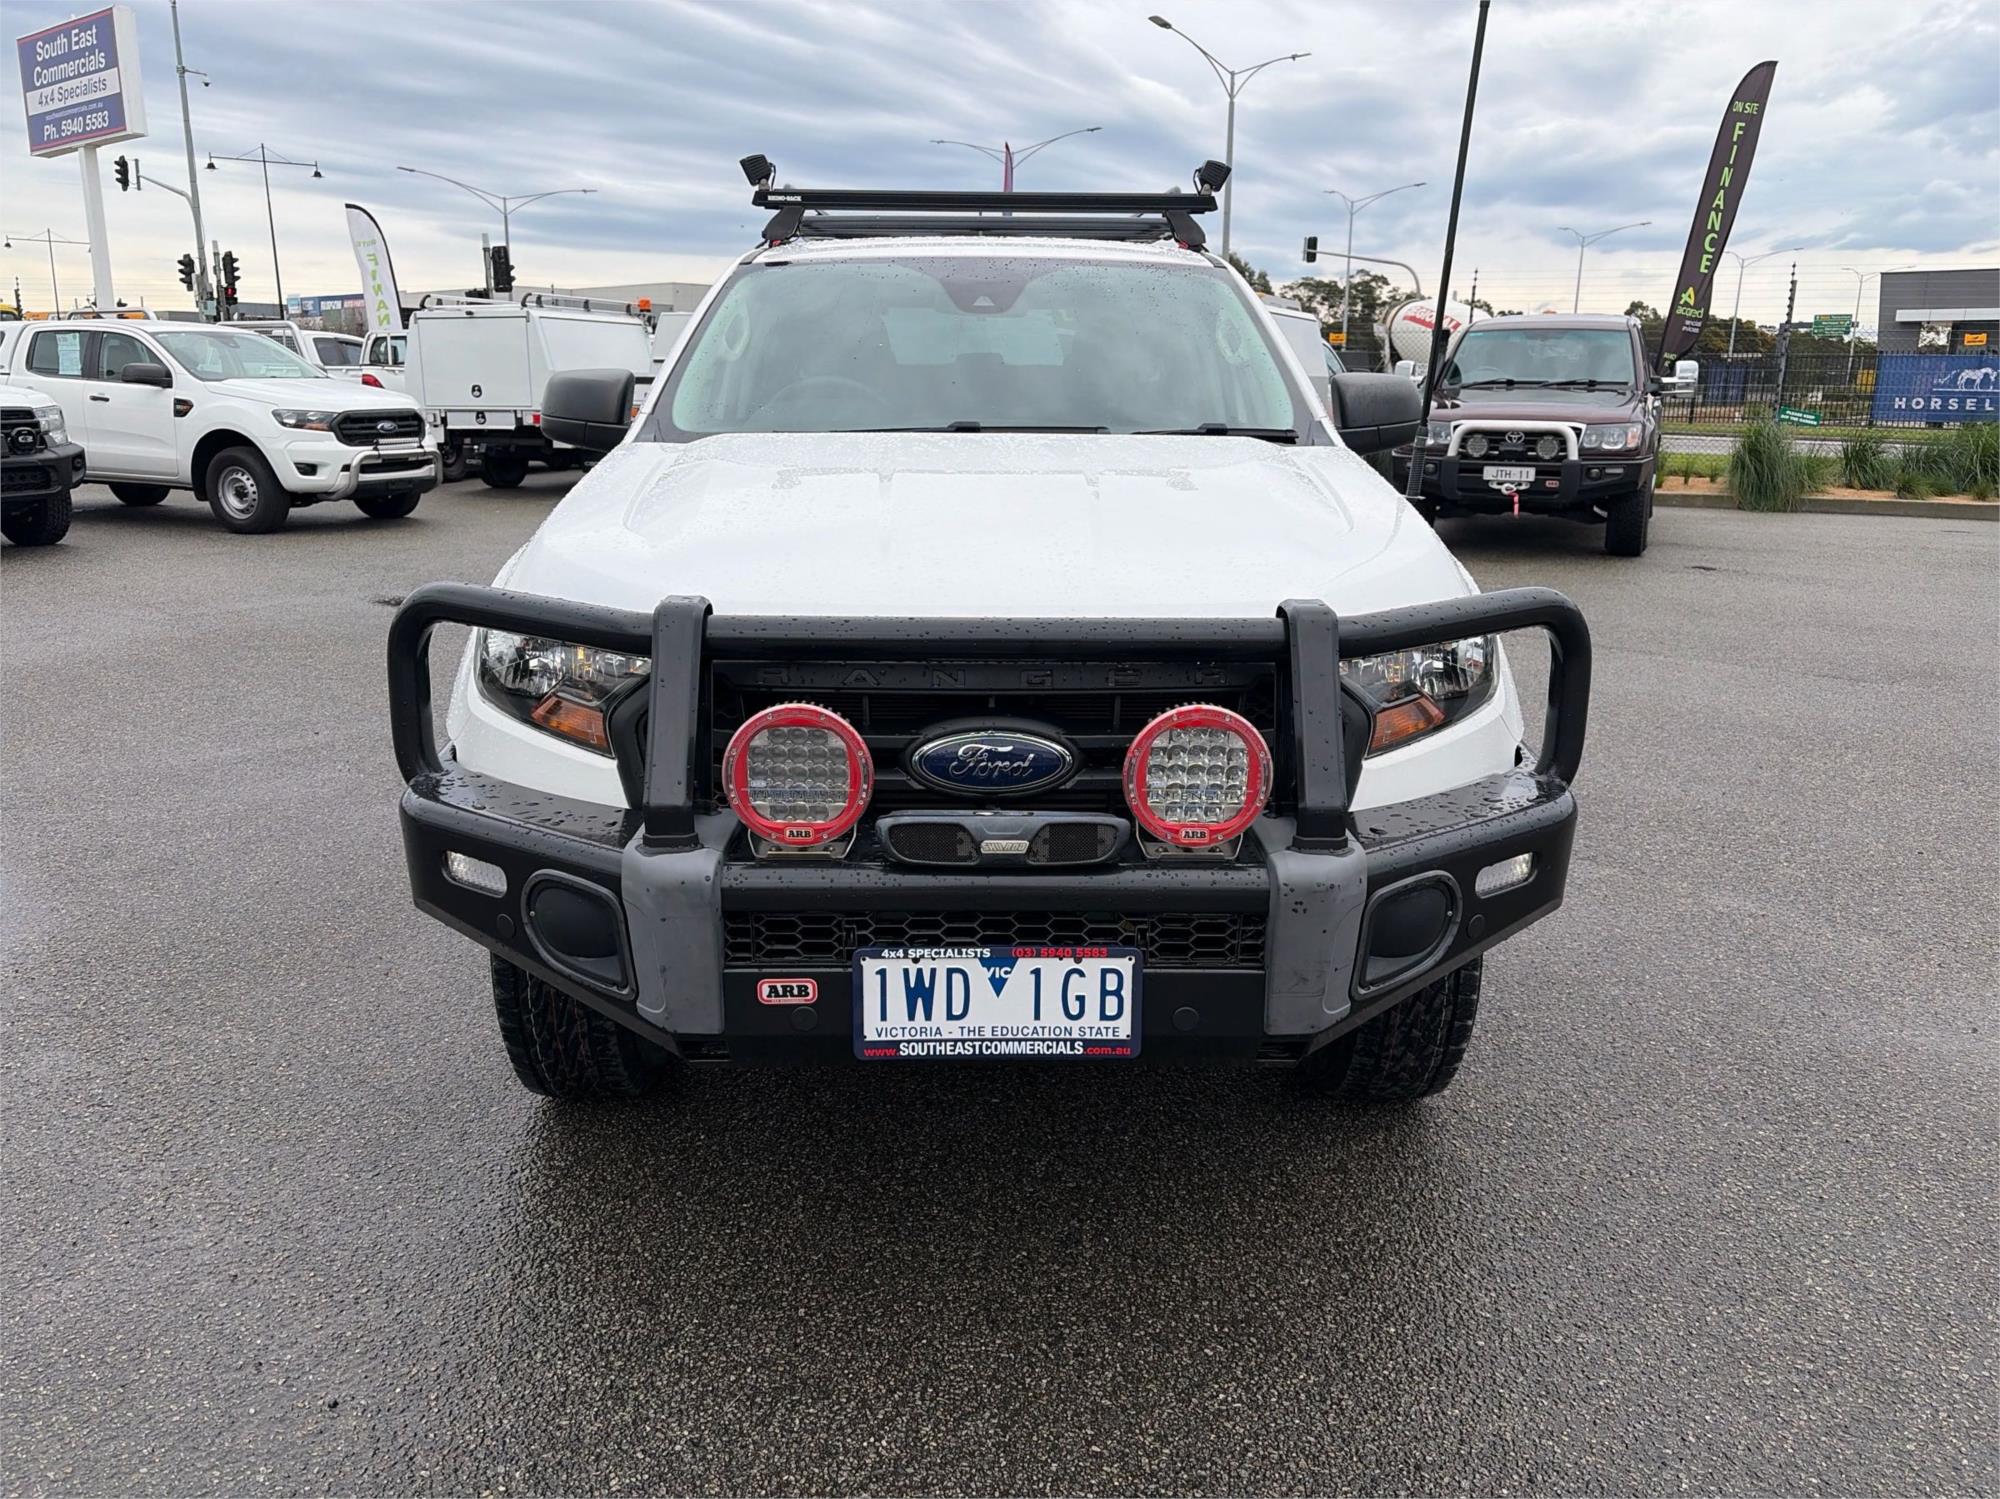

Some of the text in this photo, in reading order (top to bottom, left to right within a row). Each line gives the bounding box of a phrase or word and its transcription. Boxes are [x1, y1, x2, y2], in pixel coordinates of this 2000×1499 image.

[36, 24, 97, 61] South East
[34, 49, 106, 86] Commercials
[38, 76, 107, 107] 4x4 Specialists
[44, 124, 59, 141] Ph.
[61, 116, 83, 136] 5940
[86, 111, 109, 131] 5583
[1700, 122, 1746, 273] FINANCE
[949, 743, 1035, 778] Ford
[787, 830, 812, 839] ARB
[1183, 831, 1206, 839] ARB
[881, 948, 991, 958] 4x4 SPECIALISTS
[1011, 947, 1108, 958] (03) 5940 5583
[983, 967, 1011, 979] VIC
[766, 985, 810, 998] ARB
[875, 967, 1125, 1022] 1WD 1GB
[875, 1026, 943, 1038] VICTORIA
[959, 1026, 985, 1037] THE
[991, 1026, 1073, 1037] EDUCATION
[1078, 1026, 1120, 1038] STATE
